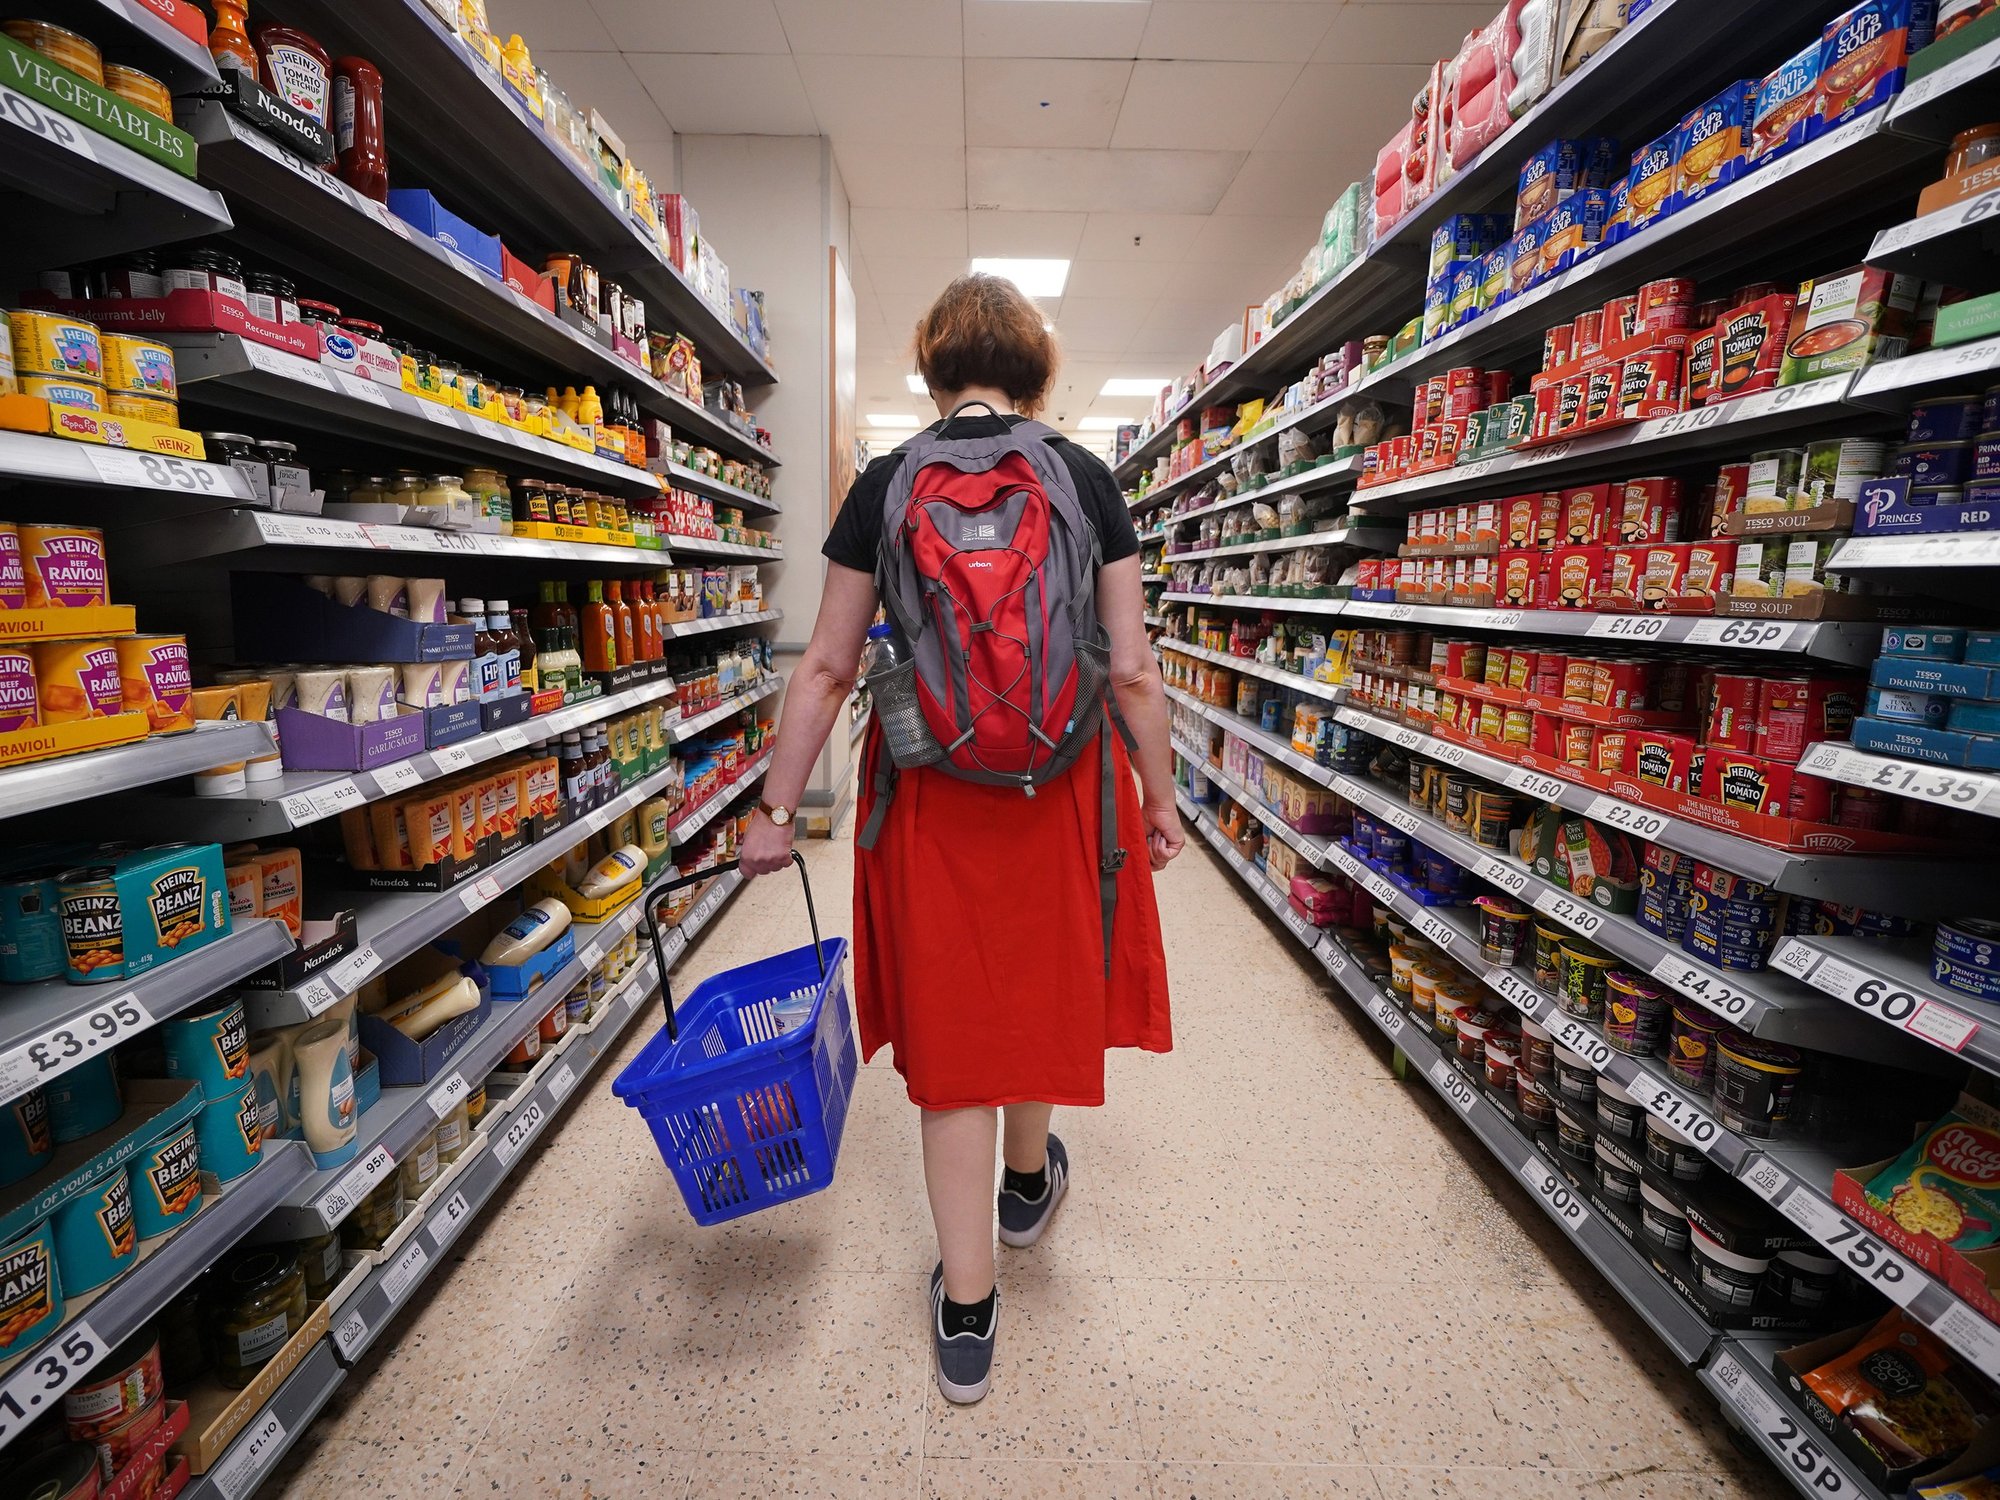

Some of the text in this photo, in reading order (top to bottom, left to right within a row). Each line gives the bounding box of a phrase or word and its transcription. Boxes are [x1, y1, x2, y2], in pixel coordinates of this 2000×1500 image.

[1837, 22, 1882, 59] SOUP
[283, 52, 319, 74] HEINZ
[282, 66, 321, 89] TOMATO
[286, 76, 321, 95] KETCHUP
[1768, 76, 1808, 108] SOUP
[7, 50, 184, 158] VEGETABLES
[1766, 94, 1808, 123] MINESTRONE
[257, 89, 322, 144] Nando's
[1691, 120, 1723, 146] SOUP
[1526, 167, 1546, 186] SOUP
[1641, 158, 1669, 181] SOUP
[1550, 217, 1572, 237] SOUP
[438, 234, 457, 250] HEINZ
[1517, 240, 1536, 257] SOUP
[1488, 260, 1505, 278] SOUP
[138, 310, 166, 323] Jelly
[1731, 314, 1761, 336] HEINZ
[66, 331, 97, 344] HEINZ
[288, 336, 306, 350] Jelly
[1725, 333, 1763, 355] TOMATO
[145, 351, 171, 365] HEINZ
[53, 389, 91, 402] HEINZ
[1651, 408, 1674, 417] HEINZ
[1655, 405, 1719, 435] £1.10
[157, 438, 191, 455] HEINZ
[139, 456, 215, 490] 85p
[1570, 508, 1590, 518] CHICKEN
[1745, 515, 1811, 529] TESCO SOUP
[1877, 512, 1922, 526] PRINCES
[1960, 510, 1990, 524] RED
[434, 530, 475, 550] £1.70
[554, 526, 565, 538] 100
[51, 540, 99, 556] HEINZ
[70, 560, 88, 568] BEEF
[1566, 558, 1585, 567] HEINZ
[49, 567, 103, 582] RAVIOLI
[1508, 571, 1526, 580] CHICKEN
[1563, 571, 1585, 580] CHICKEN
[1389, 605, 1412, 620] 65p
[1730, 601, 1793, 614] TESCO SOUP
[1607, 618, 1663, 636] £1.60
[1719, 621, 1782, 646] 65p
[484, 663, 499, 681] HP
[508, 660, 521, 678] HP
[631, 669, 648, 681] Nando's
[651, 665, 667, 676] Nando's
[1568, 665, 1594, 675] HEINZ
[1915, 670, 1942, 681] TESCO
[613, 673, 631, 685] Nando's
[1889, 677, 1967, 695] DRAINED TUNA
[1620, 716, 1642, 724] HEINZ
[385, 728, 403, 738] TESCO
[1395, 730, 1418, 748] 65p
[1895, 734, 1923, 745] TESCO
[450, 752, 466, 762] 95p
[1433, 745, 1464, 762] £1.60
[1645, 745, 1668, 759] HEINZ
[1822, 749, 1840, 758] 12R
[1870, 740, 1949, 761] DRAINED TUNA
[1640, 760, 1668, 775] TOMATO
[1731, 767, 1760, 782] HEINZ
[334, 785, 357, 799] £1.25
[1520, 775, 1562, 798] £1.60
[1616, 784, 1640, 797] HEINZ
[1725, 782, 1761, 800] TOMATO
[1871, 764, 1979, 802] £1.35
[1343, 785, 1364, 802] £1.35
[1678, 804, 1740, 829] FAVOURITE RECIPES
[1686, 799, 1730, 818] THE NATION'S
[542, 820, 561, 836] Nando's
[690, 819, 700, 830] £3
[1392, 812, 1418, 832] £1.35
[1605, 806, 1661, 835] £2.80
[500, 840, 522, 857] Nando's
[1807, 833, 1849, 851] HEINZ
[453, 862, 479, 882] Nando's
[1337, 854, 1358, 874] £1.05
[159, 872, 194, 893] HEINZ
[370, 878, 410, 887] Nando's
[1486, 865, 1525, 891] £2.80
[1696, 877, 1710, 888] PACK
[1701, 870, 1708, 880] 4
[712, 886, 725, 902] 90p
[1371, 880, 1395, 901] £1.05
[68, 897, 116, 914] HEINZ
[157, 885, 201, 915] BEANZ
[694, 905, 707, 922] 90p
[1551, 901, 1600, 932] £2.80
[1696, 912, 1717, 926] PRINCES
[64, 913, 122, 934] BEANZ
[1422, 918, 1453, 943] £1.10
[1695, 925, 1718, 940] CHUNKS
[303, 943, 344, 973] Nando's
[353, 949, 374, 969] £2.10
[1326, 950, 1343, 971] 90p
[1786, 952, 1808, 968] 01C
[1794, 946, 1811, 958] 12R
[1951, 965, 1986, 982] PRINCES
[308, 988, 330, 1005] 02C
[1498, 976, 1538, 1010] £1.10
[1678, 970, 1746, 1014] £4.20
[1378, 1005, 1401, 1031] 90p
[27, 1000, 141, 1073] £3.95
[446, 1075, 463, 1096] 95p
[1443, 1073, 1472, 1105] 90p
[1650, 1091, 1715, 1142] £1.10
[507, 1105, 541, 1147] £2.20
[1597, 1132, 1643, 1175] #YOUCANMAKEIT
[366, 1153, 386, 1174] 95p
[1763, 1164, 1781, 1179] 12R
[41, 1194, 58, 1209] OF
[61, 1168, 93, 1196] YOUR
[96, 1162, 103, 1172] 5
[106, 1156, 114, 1168] A
[115, 1141, 135, 1161] DAY
[1755, 1170, 1778, 1190] 01B
[1540, 1175, 1580, 1218] 90p
[326, 1196, 349, 1217] 02B
[447, 1196, 465, 1221] £1
[1591, 1195, 1634, 1239] #YOUCANMAKEIT
[1686, 1205, 1725, 1245] POT noodle
[1824, 1217, 1905, 1283] 75p
[343, 1321, 362, 1343] 02A
[1720, 1365, 1739, 1386] 01A
[1728, 1360, 1743, 1377] 12R
[1872, 1356, 1909, 1386] FOOD
[0, 1331, 95, 1437] 1.35
[250, 1421, 278, 1457] £1.10
[118, 1425, 175, 1494] BEANS
[1768, 1417, 1842, 1494] 25p
